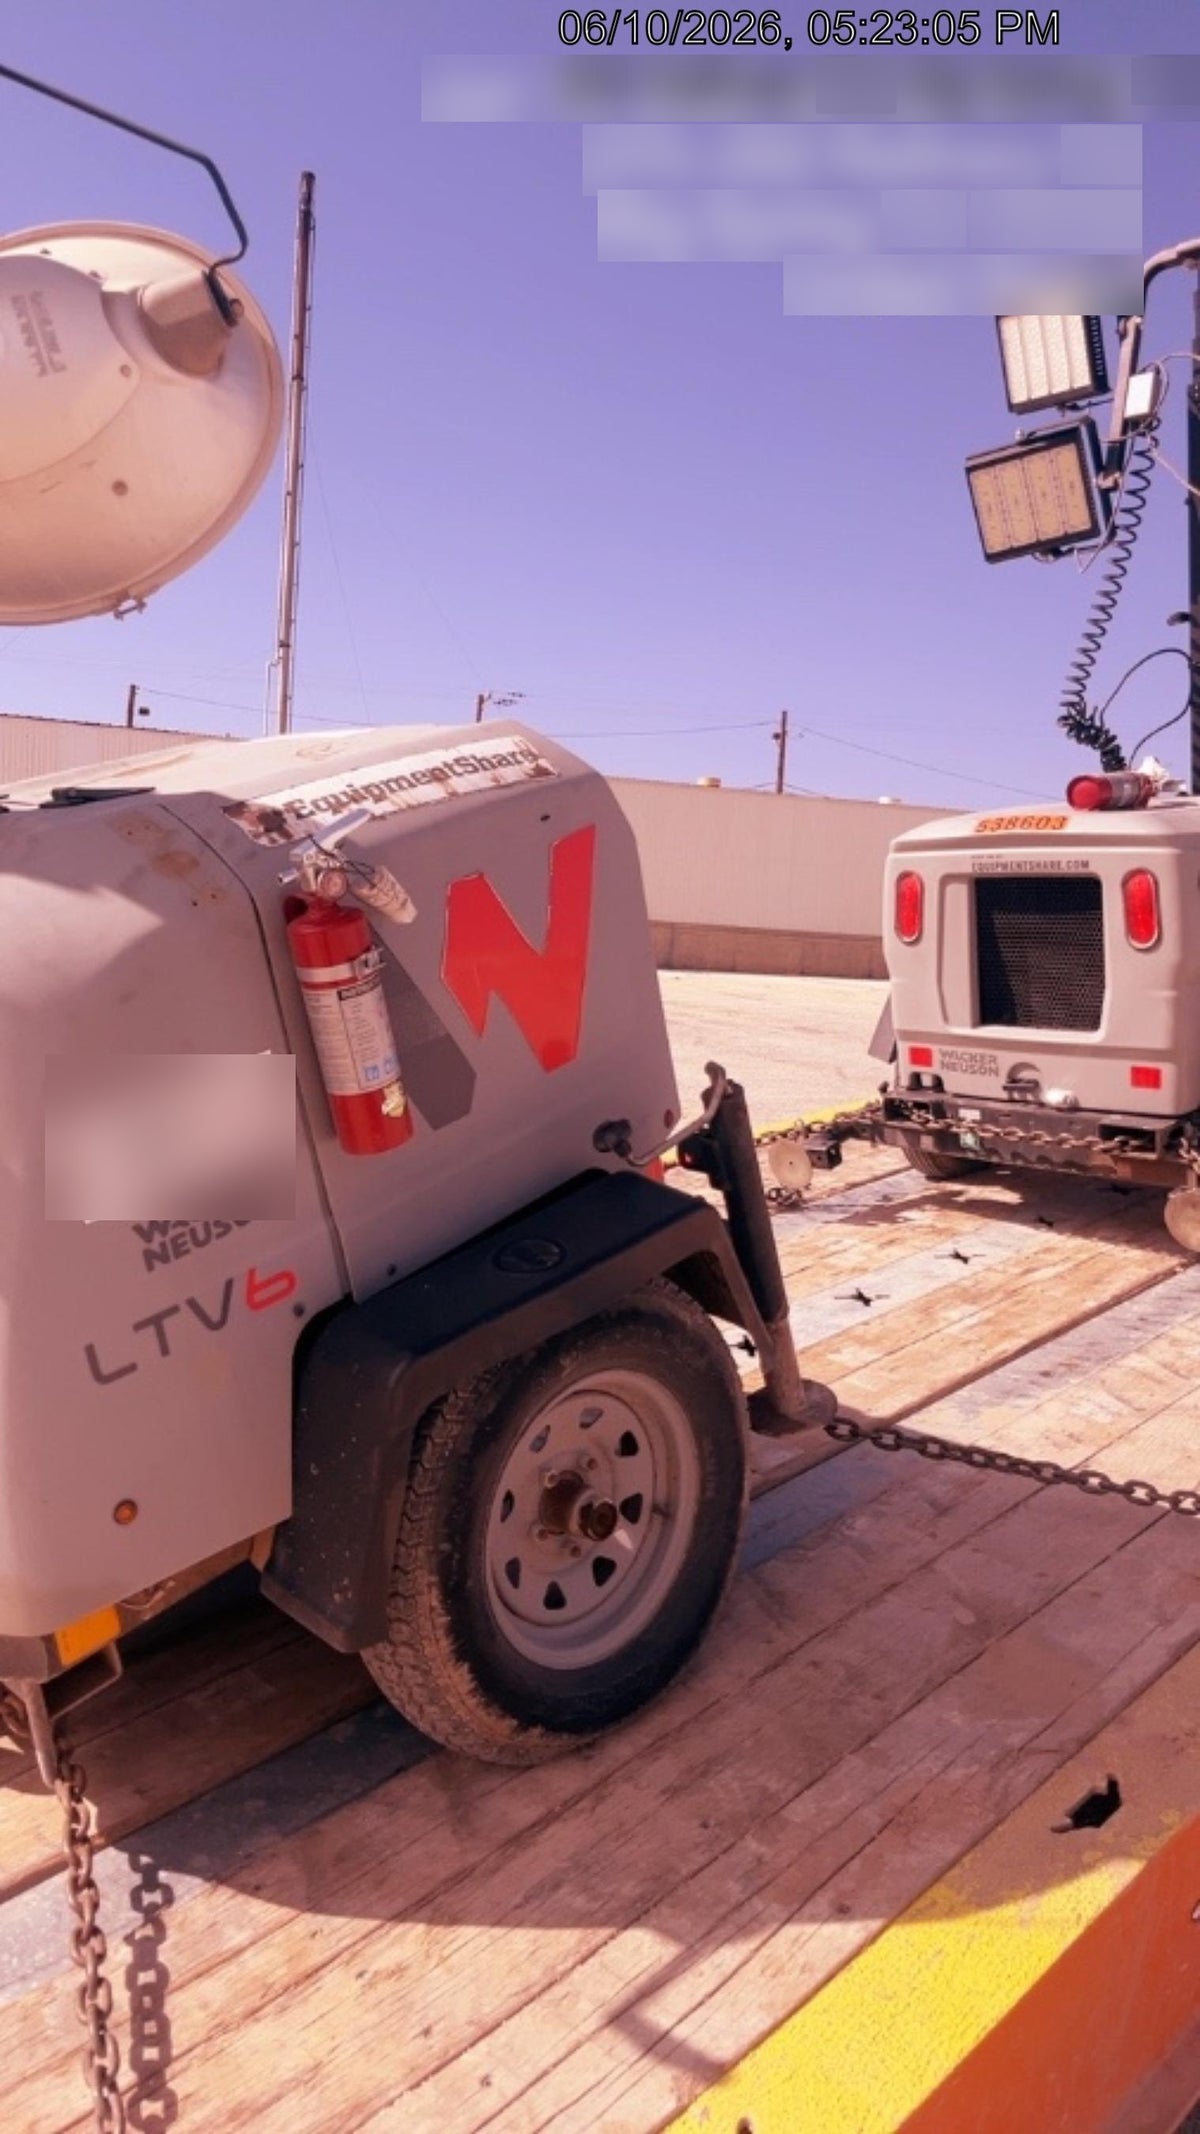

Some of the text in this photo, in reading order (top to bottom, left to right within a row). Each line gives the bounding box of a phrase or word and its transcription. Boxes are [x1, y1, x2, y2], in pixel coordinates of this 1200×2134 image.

[974, 814, 1069, 833] 538603
[970, 859, 1090, 874] EQUIPMENTSHARE.COM
[938, 1047, 998, 1066] WACKER
[940, 1058, 1000, 1078] NEUSON
[142, 1219, 251, 1273] NEUS
[84, 1265, 297, 1386] LTV6
